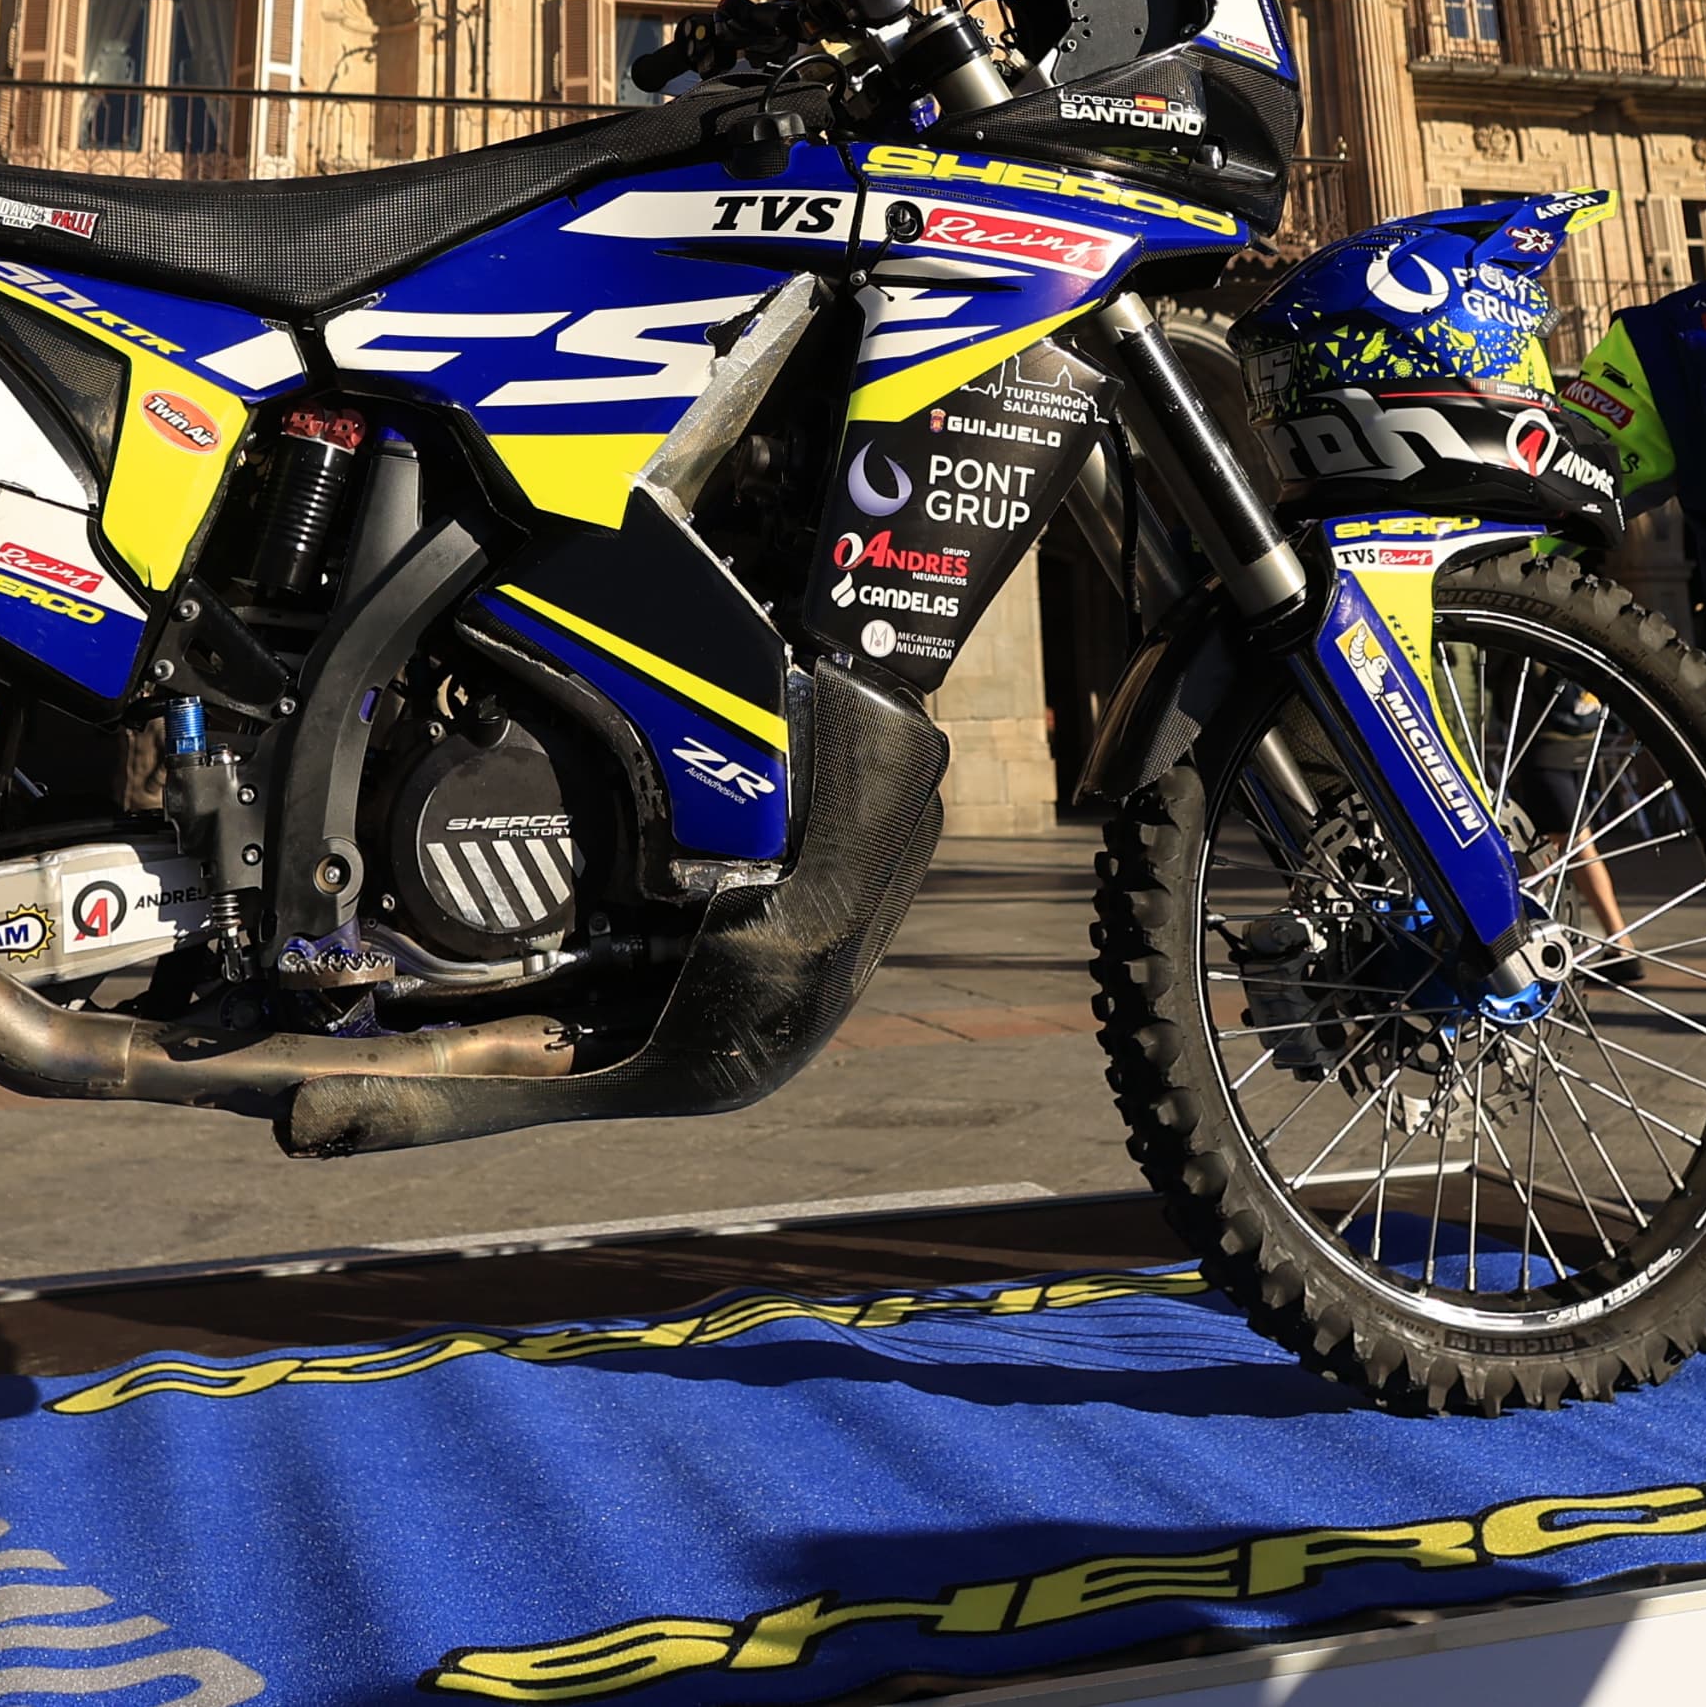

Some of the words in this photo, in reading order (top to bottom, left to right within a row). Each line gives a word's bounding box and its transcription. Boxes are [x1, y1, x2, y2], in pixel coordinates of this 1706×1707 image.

[1059, 89, 1134, 109] Lorenzo
[1061, 103, 1203, 136] SANTOLINO
[861, 145, 1237, 236] SHERCO
[3, 217, 34, 229] ITALY
[50, 210, 98, 238] VALLE
[1535, 196, 1599, 220] AIROH
[712, 195, 842, 234] TVS
[925, 214, 1111, 263] Racing
[1462, 289, 1534, 332] GRUP
[83, 310, 186, 356] RTR
[1003, 400, 1087, 425] SALAMANCA
[1565, 380, 1627, 425] MOTUL
[146, 395, 191, 435] Twin
[184, 425, 217, 449] Air
[946, 415, 1062, 448] GUIJUELO
[929, 454, 1035, 497] PONT
[925, 490, 1031, 531] GRUP
[942, 546, 971, 558] GRUPO
[1338, 549, 1376, 564] TVS
[1380, 550, 1432, 565] Racing
[912, 572, 968, 587] NEUMATICOS
[859, 585, 960, 617] CANDELAS
[895, 642, 953, 660] MUNTADA
[897, 631, 956, 648] MECANITZATS
[672, 736, 776, 800] ZR
[1384, 689, 1487, 832] MICHELIN
